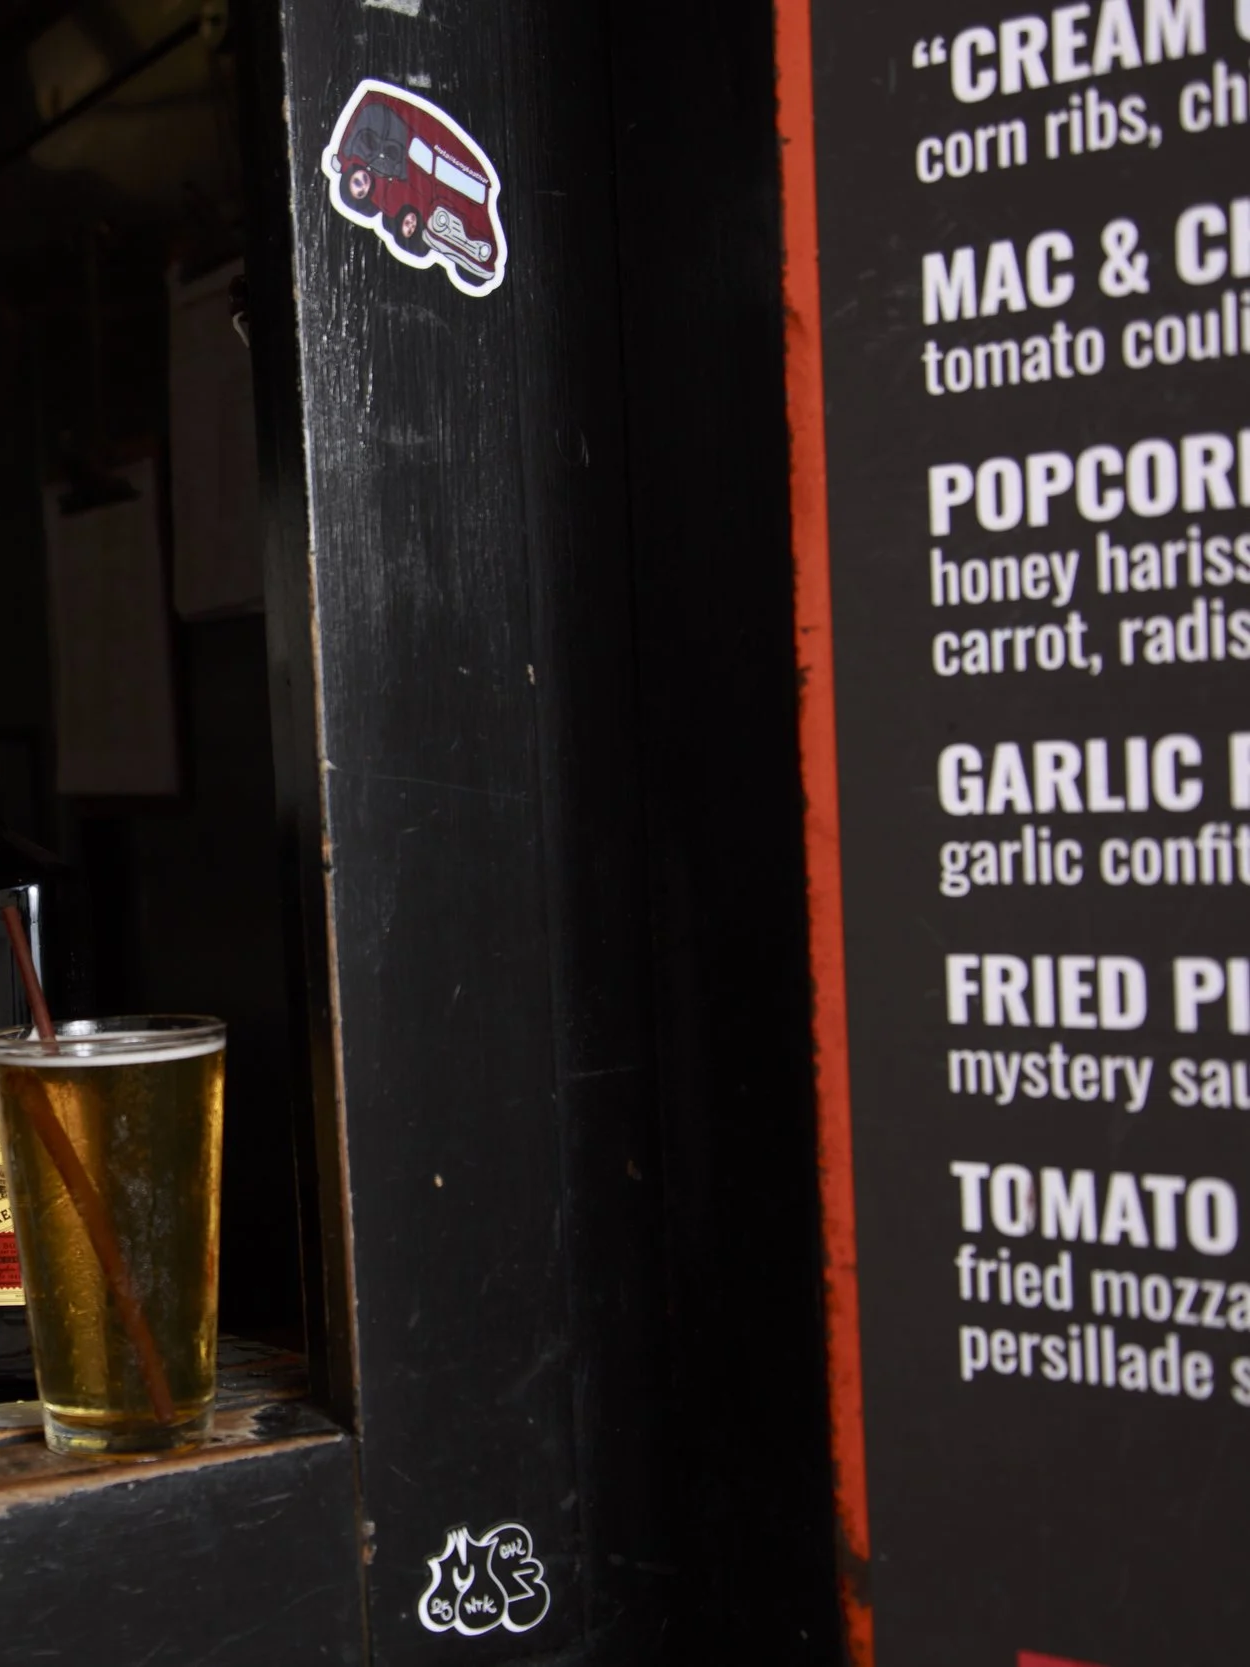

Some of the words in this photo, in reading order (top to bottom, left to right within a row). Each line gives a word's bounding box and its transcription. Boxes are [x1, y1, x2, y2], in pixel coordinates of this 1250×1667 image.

[911, 0, 1206, 104] “CREAM
[915, 118, 1028, 184] corn
[1045, 86, 1163, 160] ribs,
[1179, 59, 1250, 133] ch
[921, 229, 1076, 327] MAC
[1098, 217, 1151, 299] &
[920, 319, 1106, 397] tomato
[927, 427, 1250, 538] POPCOR
[929, 546, 1081, 608] honey
[1095, 524, 1250, 595] hariss
[931, 610, 1104, 677] carrot,
[1118, 596, 1250, 667] radis
[936, 732, 1204, 818] GARLIC
[939, 822, 1084, 899] garlic
[1099, 820, 1250, 887] confit
[944, 952, 1148, 1032] FRIED
[947, 1041, 1154, 1114] mystery
[949, 1159, 1239, 1257] TOMATO
[954, 1242, 1074, 1313] fried
[1090, 1269, 1250, 1332] mozza
[959, 1324, 1215, 1400] persillade
